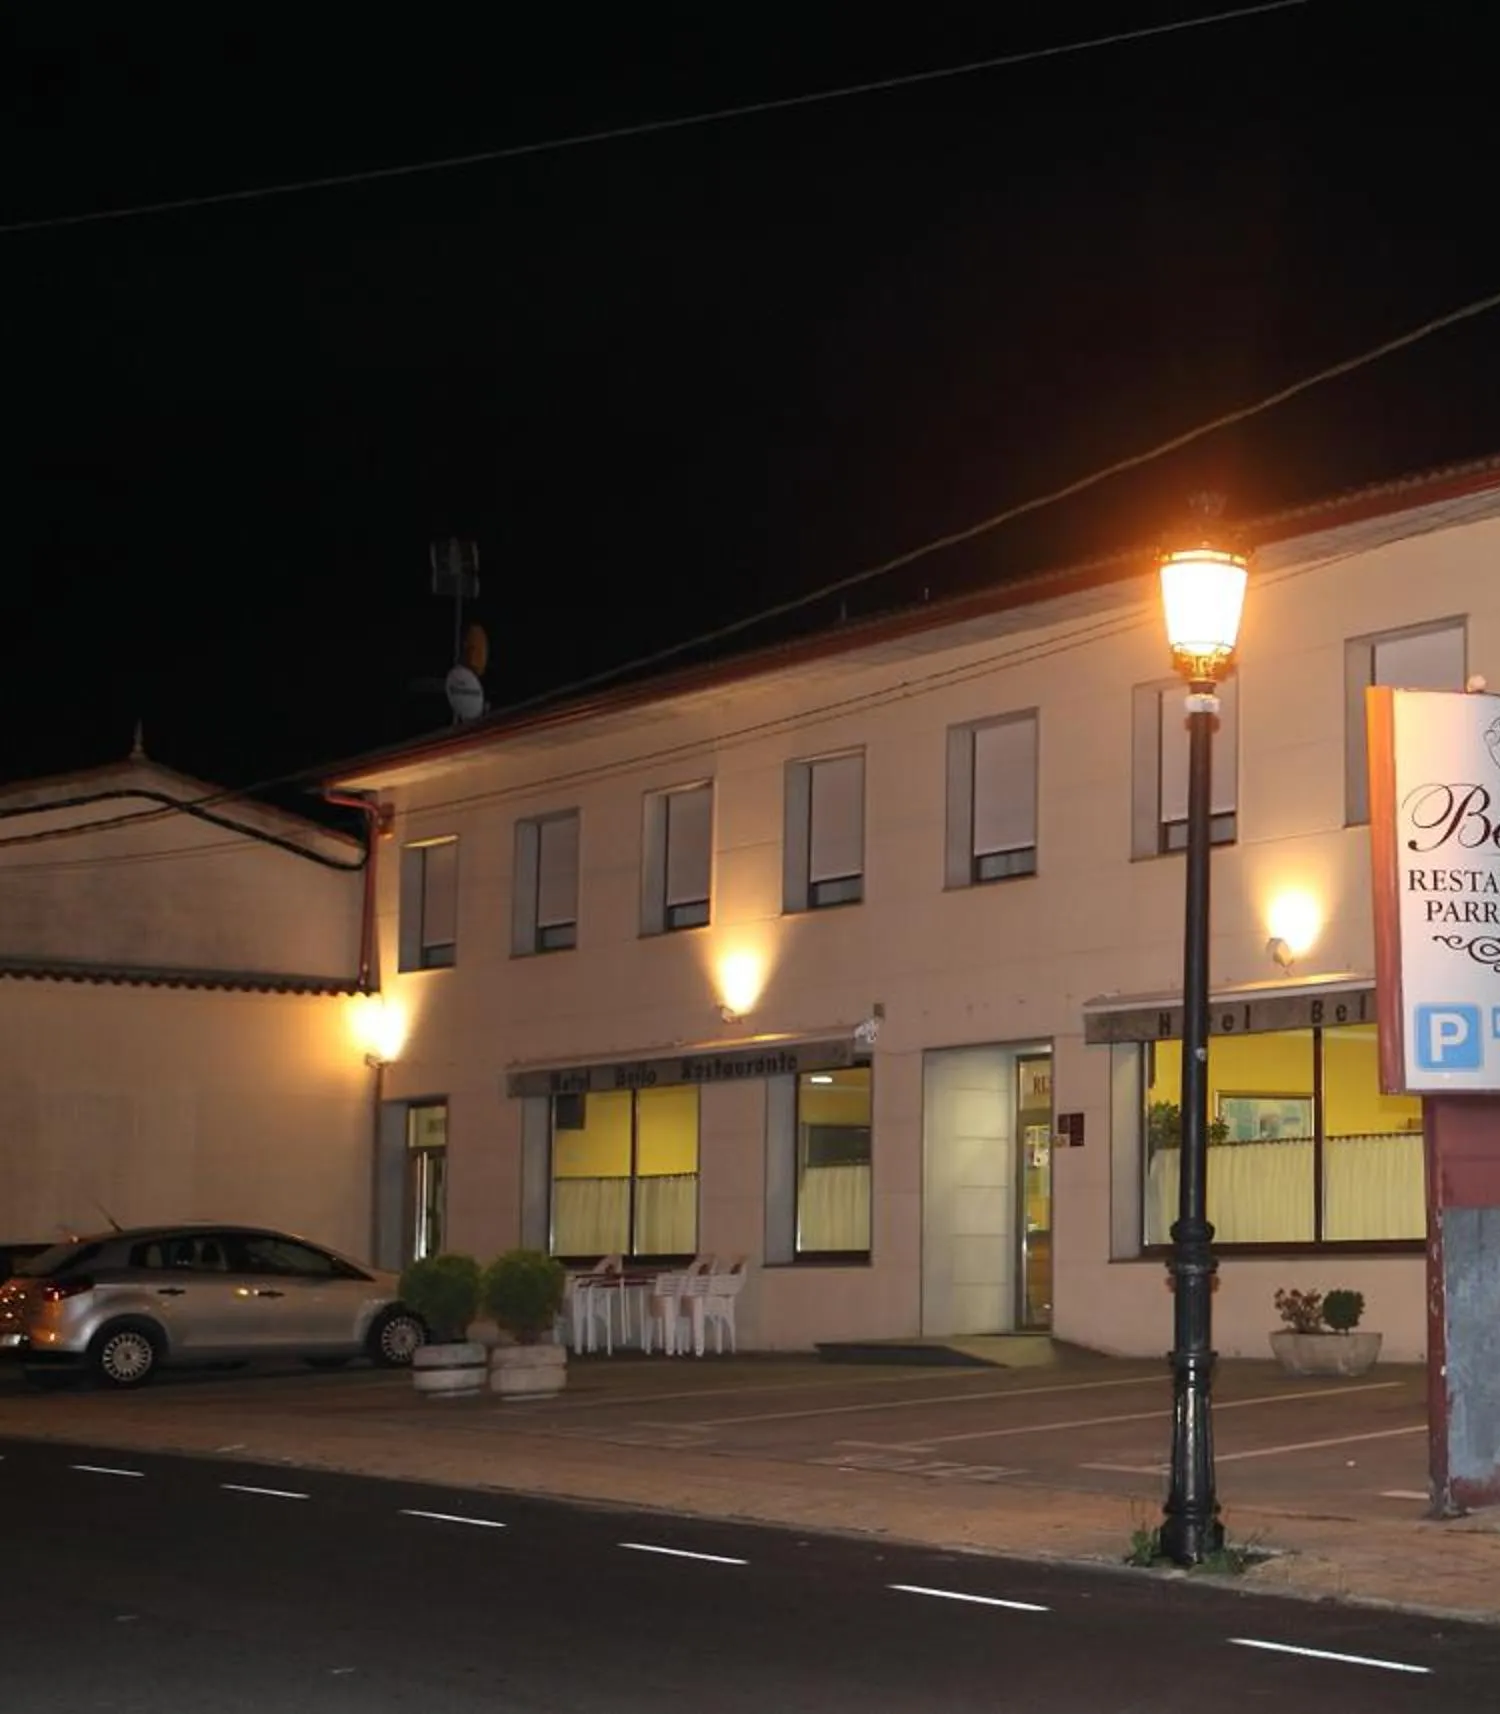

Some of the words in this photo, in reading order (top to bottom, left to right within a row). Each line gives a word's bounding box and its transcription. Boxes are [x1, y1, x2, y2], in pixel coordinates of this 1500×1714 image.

[1159, 1004, 1251, 1037] Hel
[1311, 994, 1367, 1024] Bel
[1430, 1013, 1469, 1062] P
